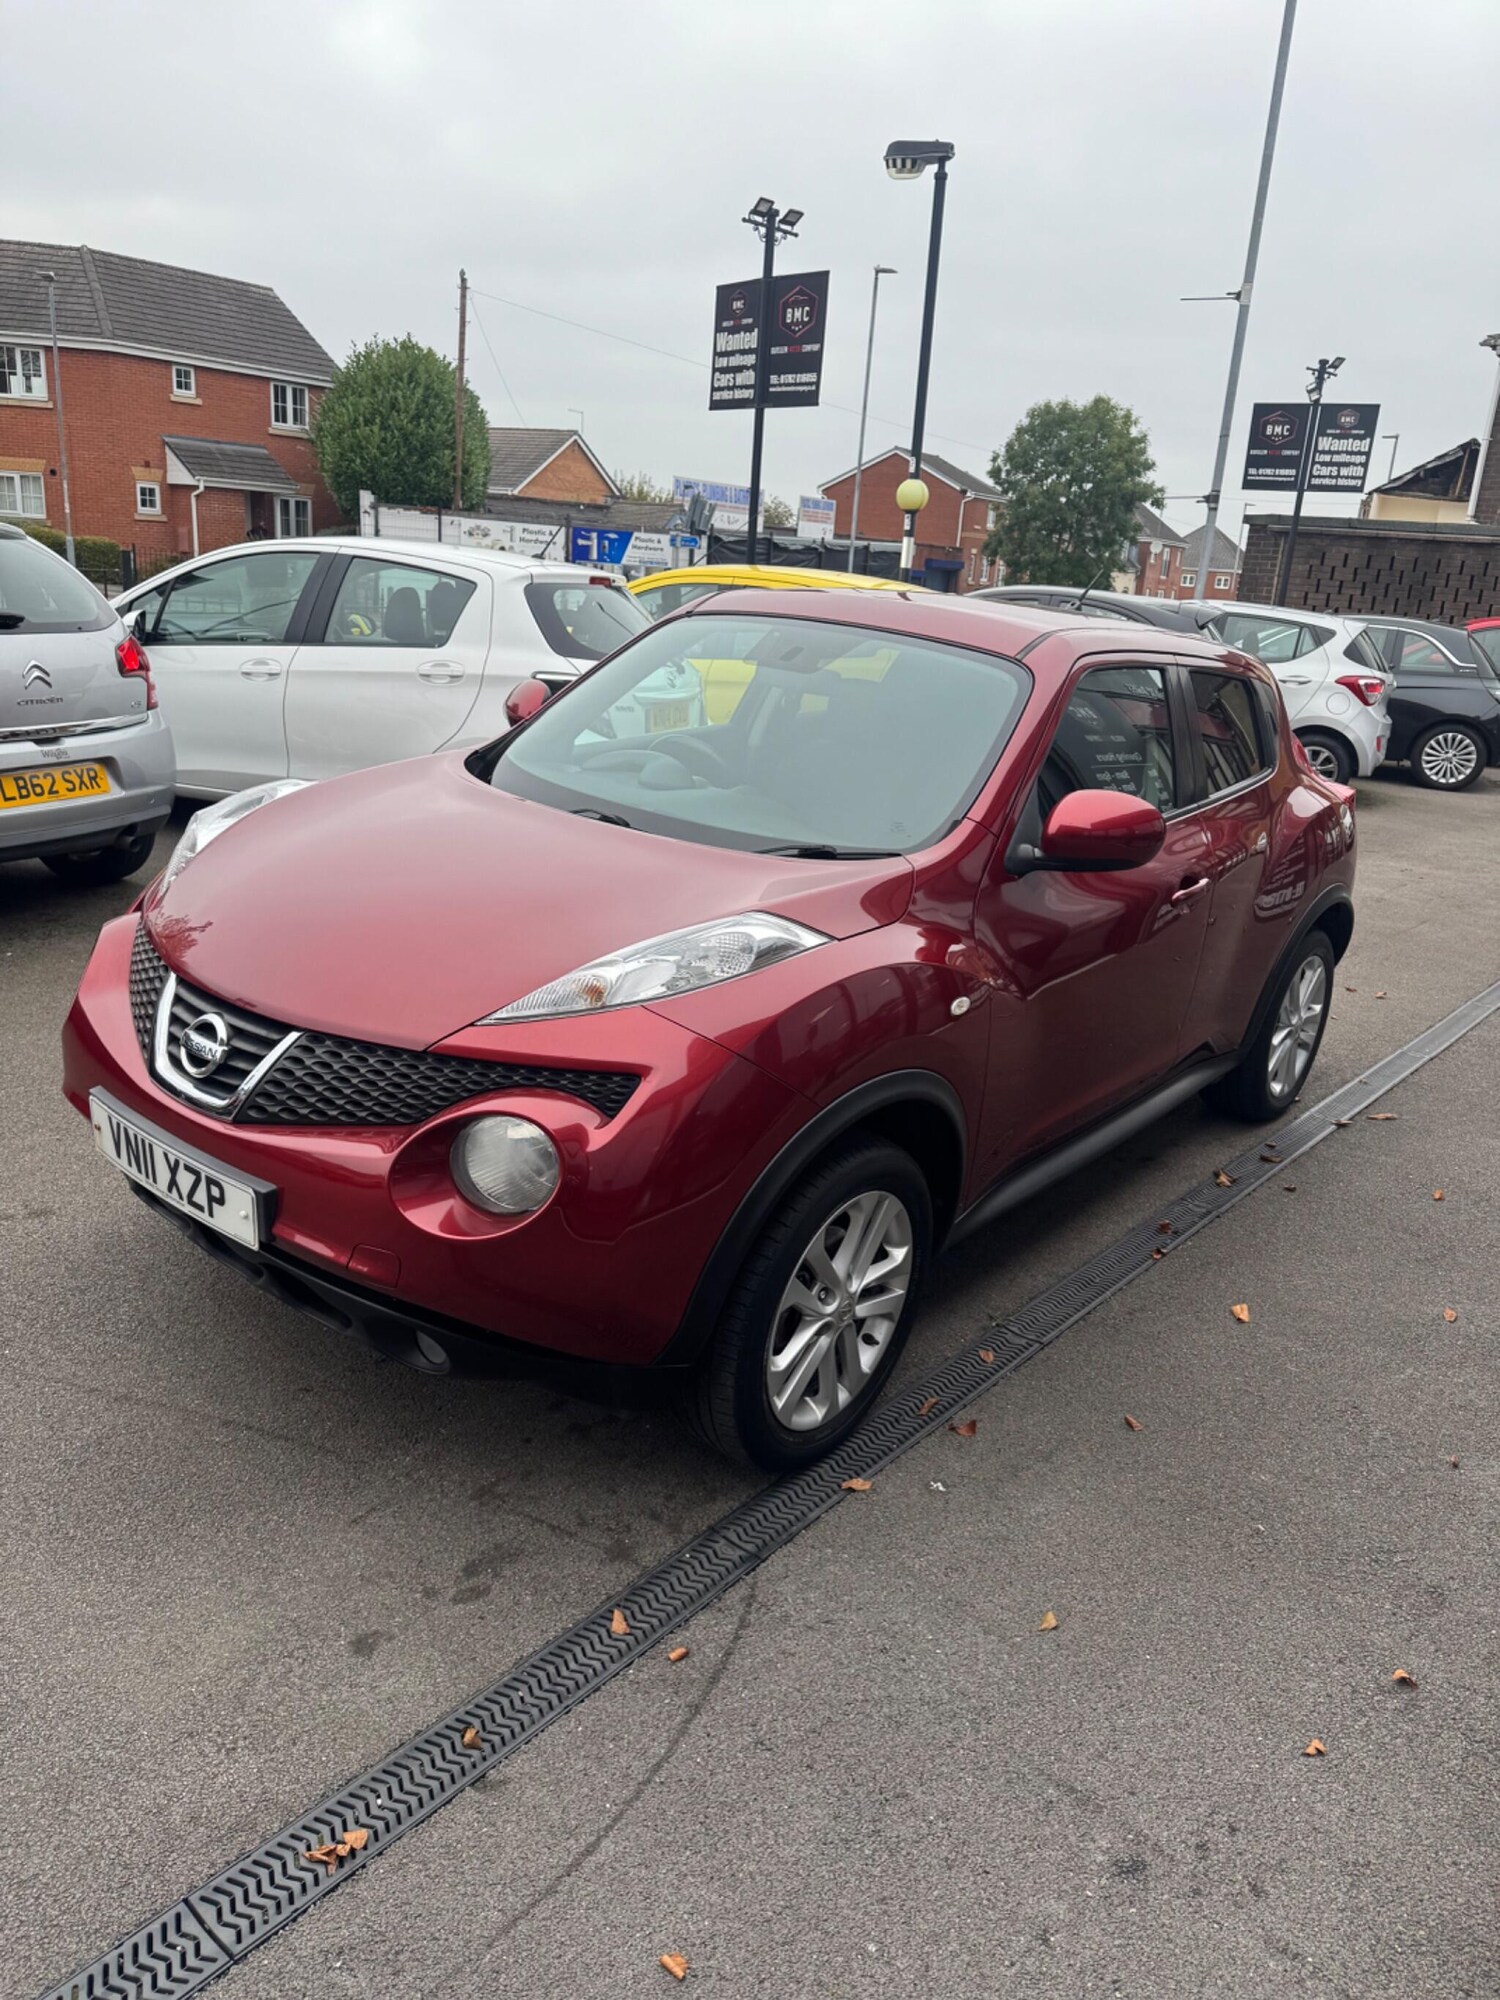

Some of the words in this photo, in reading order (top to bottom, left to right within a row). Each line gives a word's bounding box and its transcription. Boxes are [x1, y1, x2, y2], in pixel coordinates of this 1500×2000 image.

[786, 306, 810, 323] BMC
[716, 328, 758, 352] Wanted
[715, 355, 728, 368] Low
[729, 353, 756, 367] mileage
[714, 371, 734, 387] Cars
[735, 369, 756, 385] with
[713, 389, 733, 401] service
[734, 388, 755, 400] history
[1266, 424, 1291, 436] BMC
[1317, 436, 1371, 452] Wanted
[1315, 452, 1332, 463] Low
[1332, 453, 1366, 464] mileage
[1312, 464, 1338, 476] Cars
[1340, 465, 1364, 477] with
[1310, 478, 1336, 487] service
[1337, 477, 1362, 488] history
[522, 527, 546, 536] Plastic
[519, 536, 557, 545] Hardwae
[634, 536, 655, 545] Plastic
[631, 544, 664, 552] Hardware
[0, 772, 59, 803] LB62
[61, 767, 102, 793] SXR
[107, 1115, 158, 1185] VN11
[163, 1151, 226, 1219] XZP
